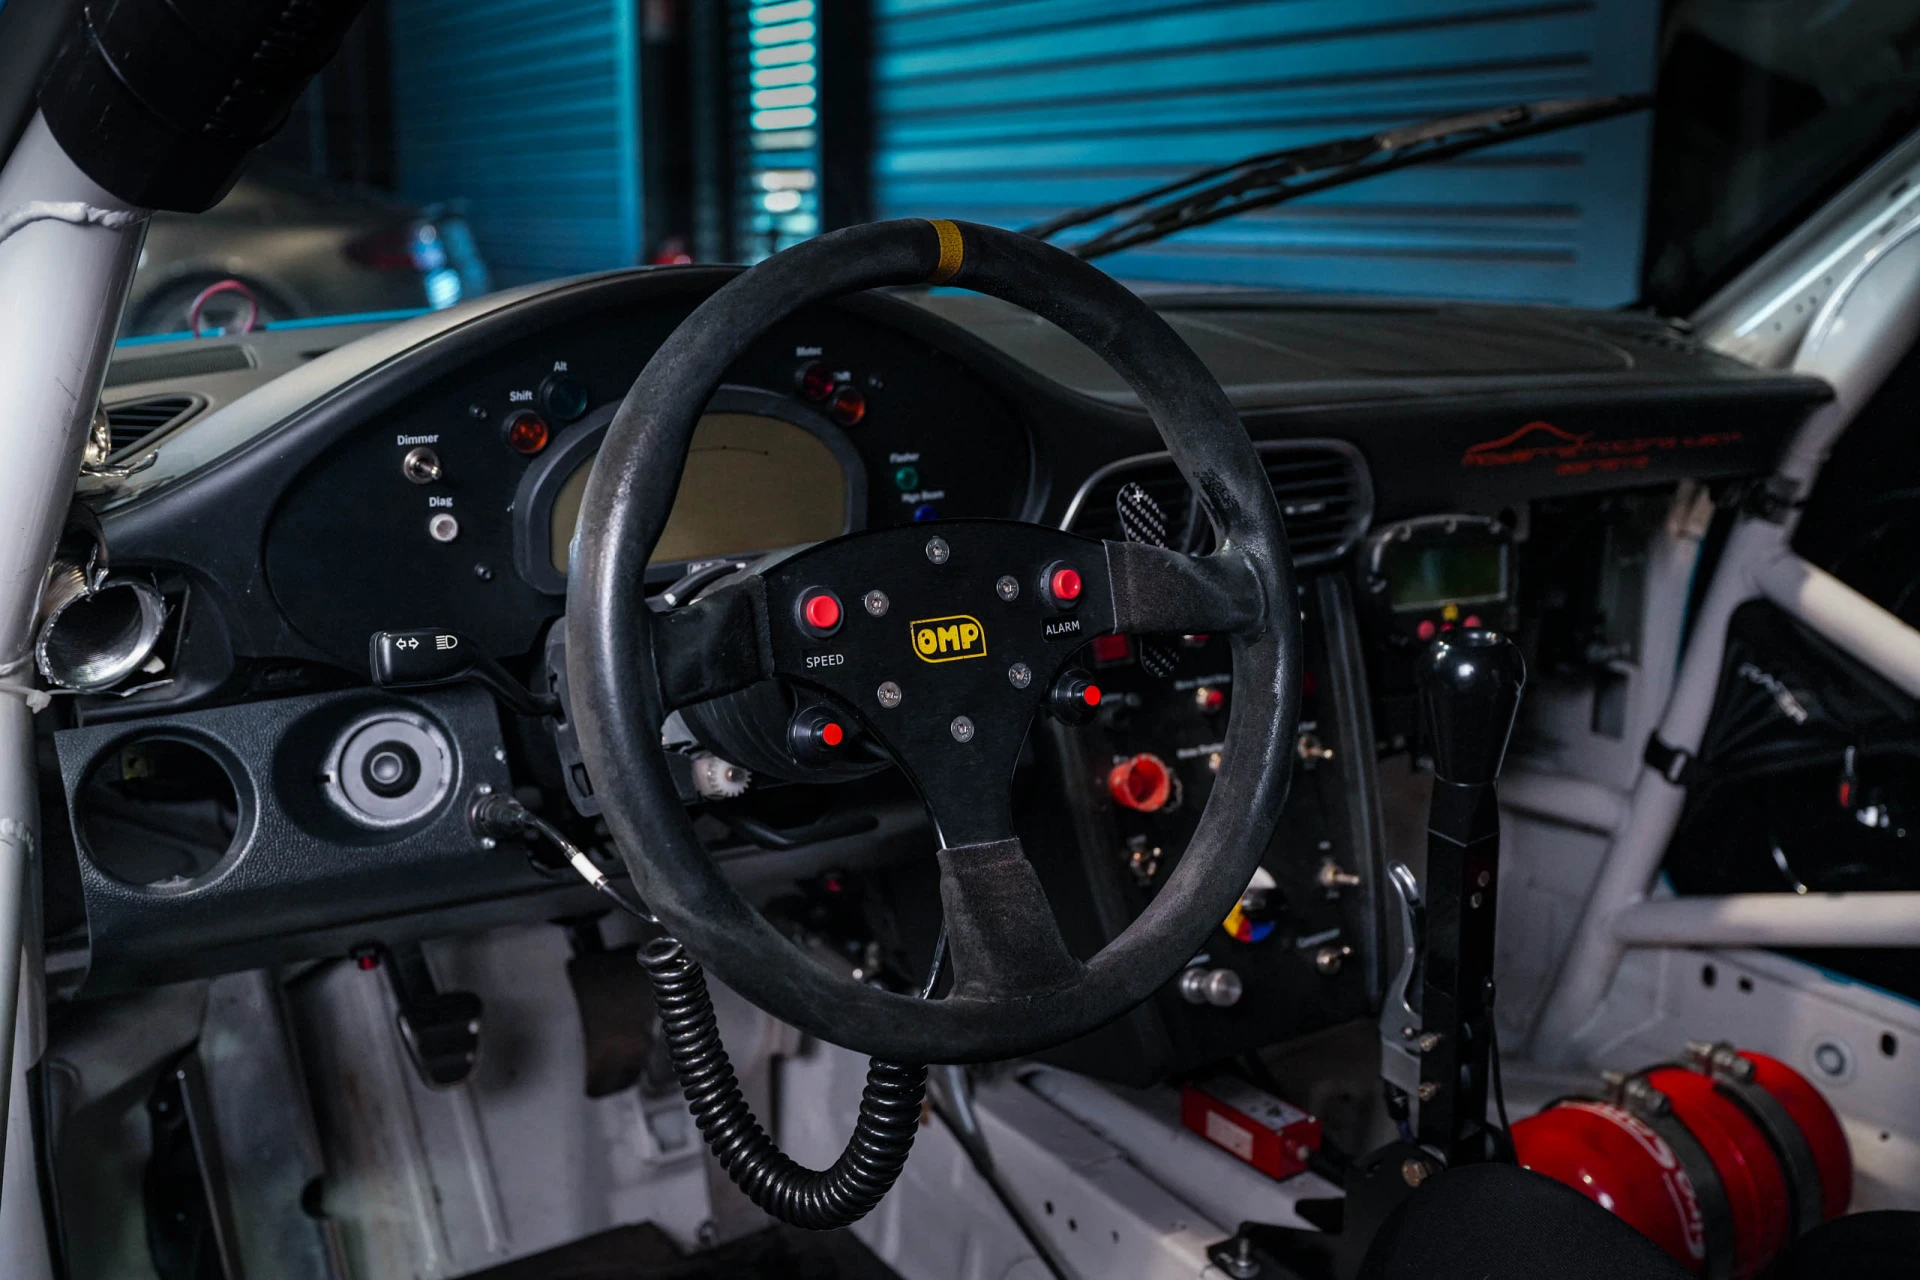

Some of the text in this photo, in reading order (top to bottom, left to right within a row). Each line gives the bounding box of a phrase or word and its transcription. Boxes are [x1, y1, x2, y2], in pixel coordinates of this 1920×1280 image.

[553, 361, 568, 372] Alt
[509, 390, 533, 402] Shift
[397, 434, 439, 446] Dimmer
[428, 496, 453, 508] Diag
[1045, 620, 1080, 636] ALARM
[917, 623, 979, 655] OMP
[806, 653, 844, 669] SPEED
